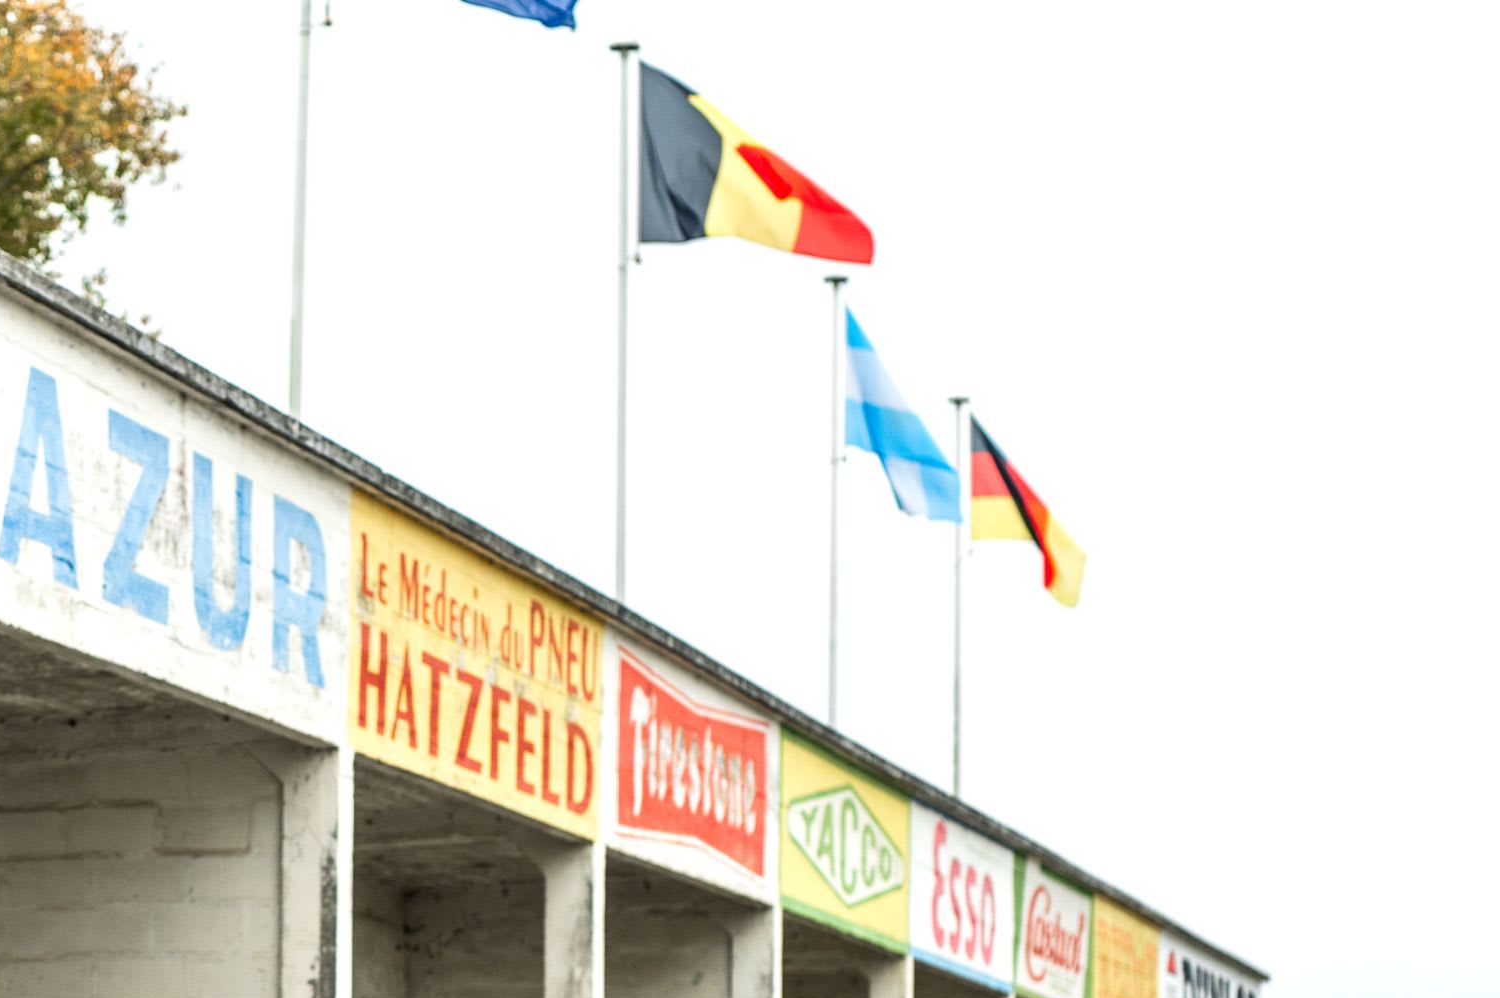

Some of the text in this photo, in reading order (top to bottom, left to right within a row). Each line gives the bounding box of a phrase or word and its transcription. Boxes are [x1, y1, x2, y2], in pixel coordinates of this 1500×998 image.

[501, 603, 523, 670] du
[530, 599, 598, 702] PNEU
[358, 622, 594, 816] HATZFELD
[630, 685, 757, 836] Firestone
[800, 798, 892, 895] YACCO
